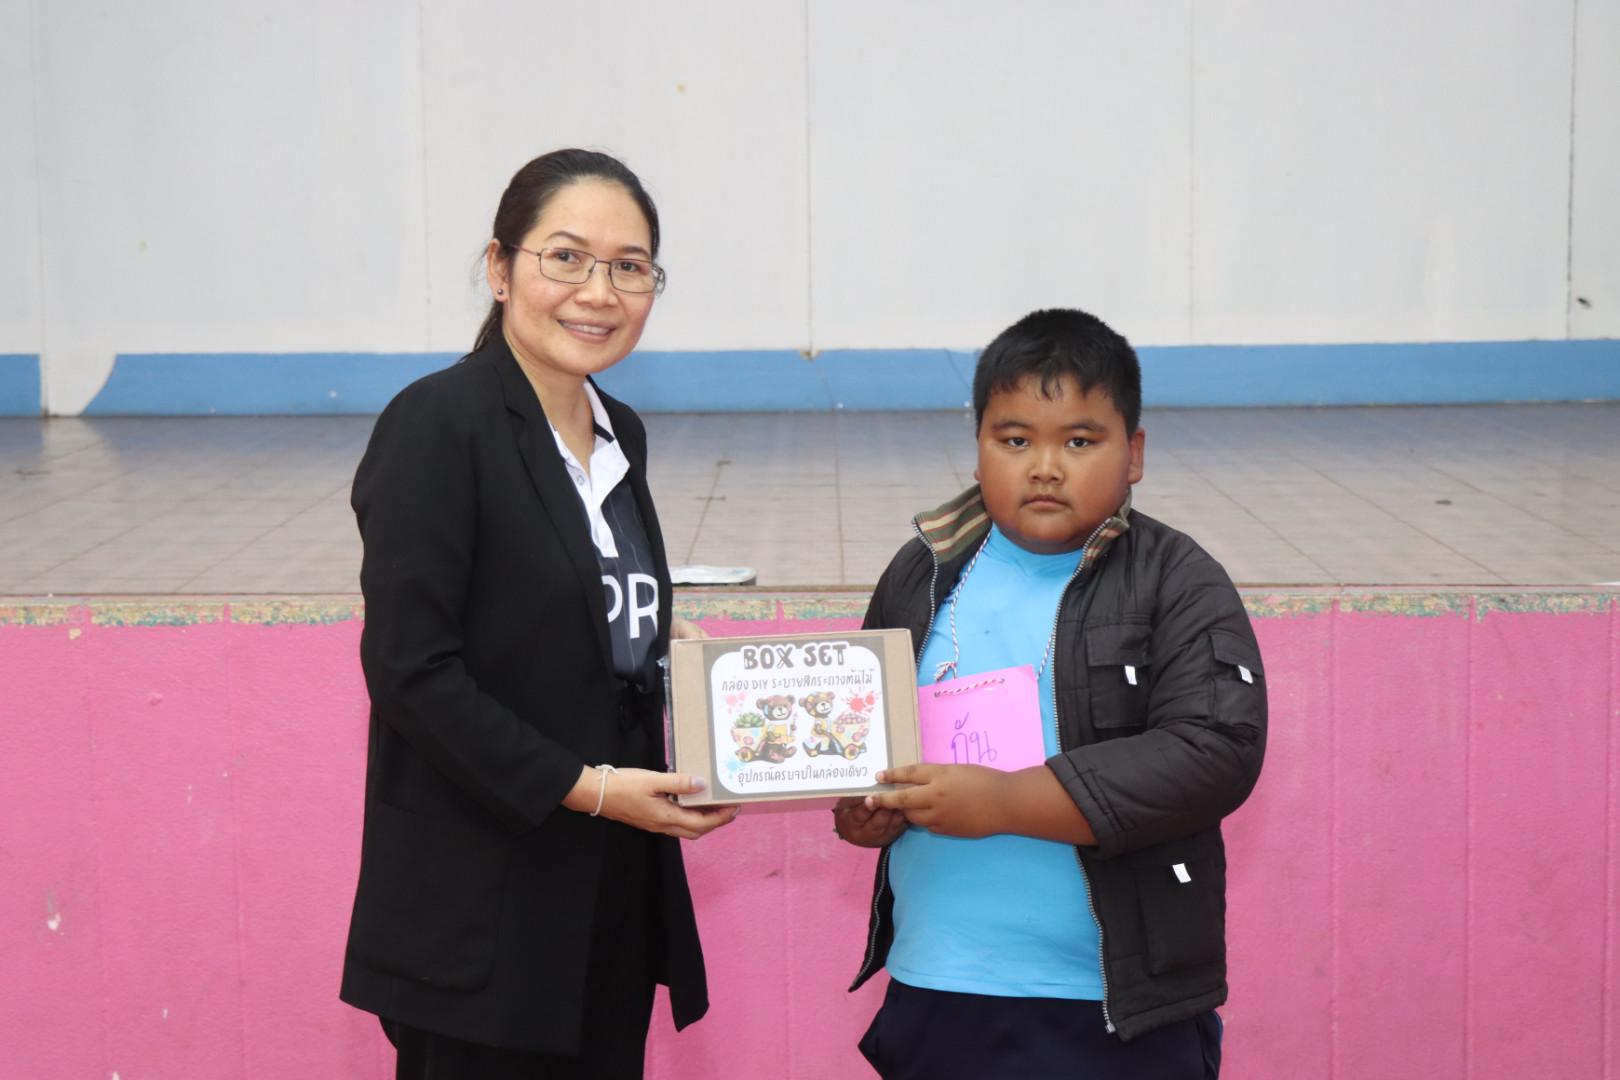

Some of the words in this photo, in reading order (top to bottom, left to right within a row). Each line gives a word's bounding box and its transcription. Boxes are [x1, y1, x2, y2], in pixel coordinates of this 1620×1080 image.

[743, 646, 795, 670] BOX
[803, 643, 848, 668] SET
[722, 674, 749, 692] กล่อง
[752, 679, 768, 690] DIY
